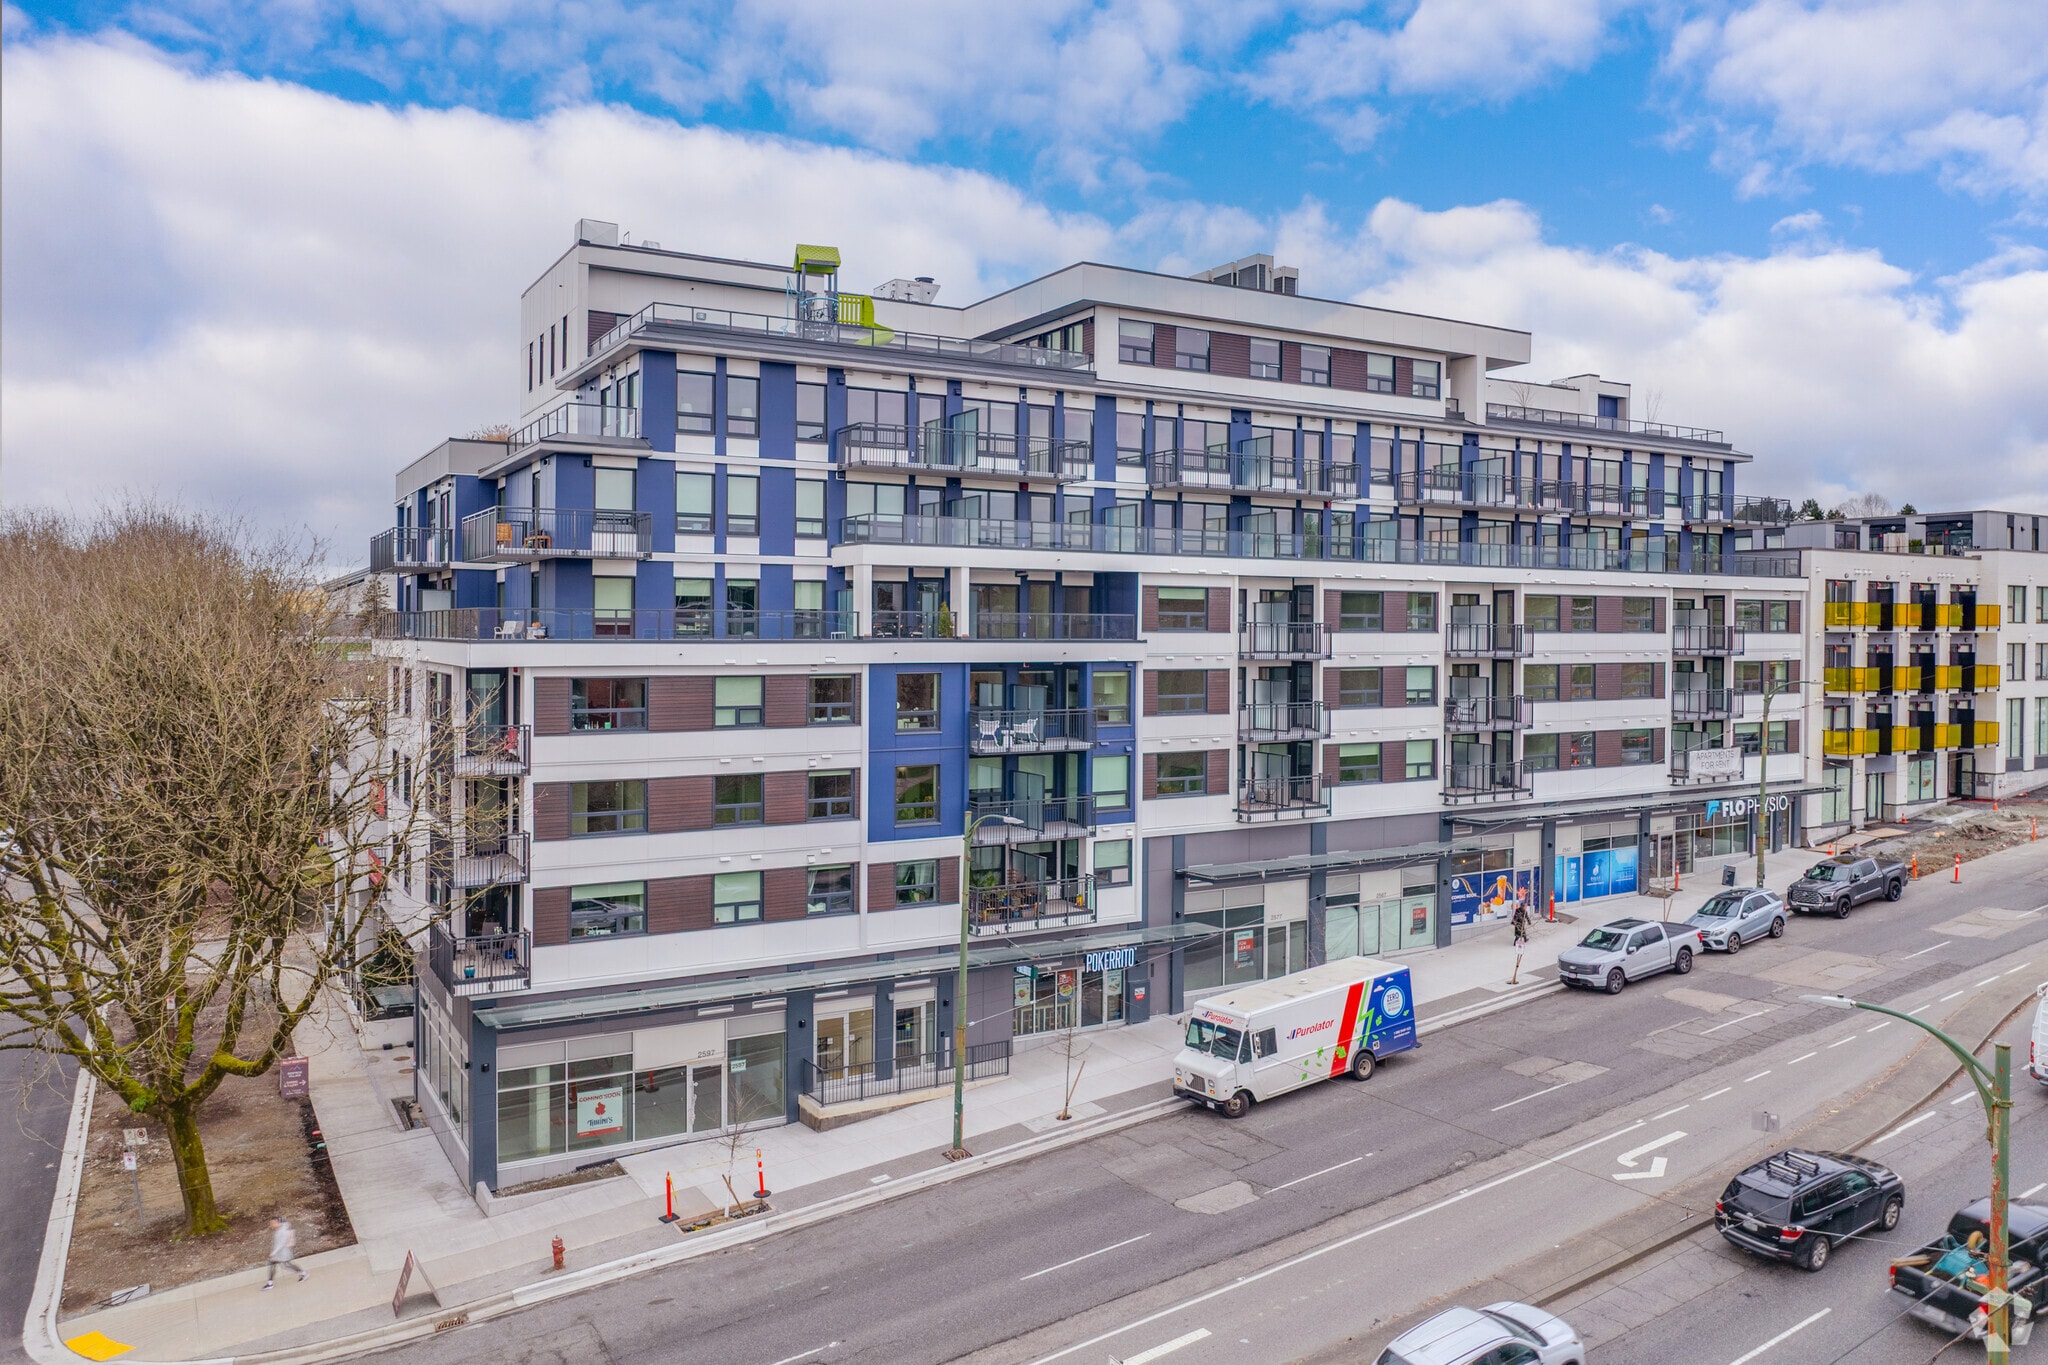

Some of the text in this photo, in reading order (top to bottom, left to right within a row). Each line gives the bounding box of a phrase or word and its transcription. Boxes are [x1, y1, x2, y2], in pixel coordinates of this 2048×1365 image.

[1696, 750, 1735, 760] APARTMENTS
[1701, 759, 1730, 770] FOR RENT
[1722, 799, 1746, 818] FLO
[1086, 948, 1135, 973] POKERRITO
[1386, 992, 1400, 1002] ZERO
[1208, 1011, 1234, 1025] Purolator
[1295, 1019, 1335, 1039] Purolator
[697, 1049, 716, 1058] 2597
[578, 1090, 622, 1103] COMING SOON
